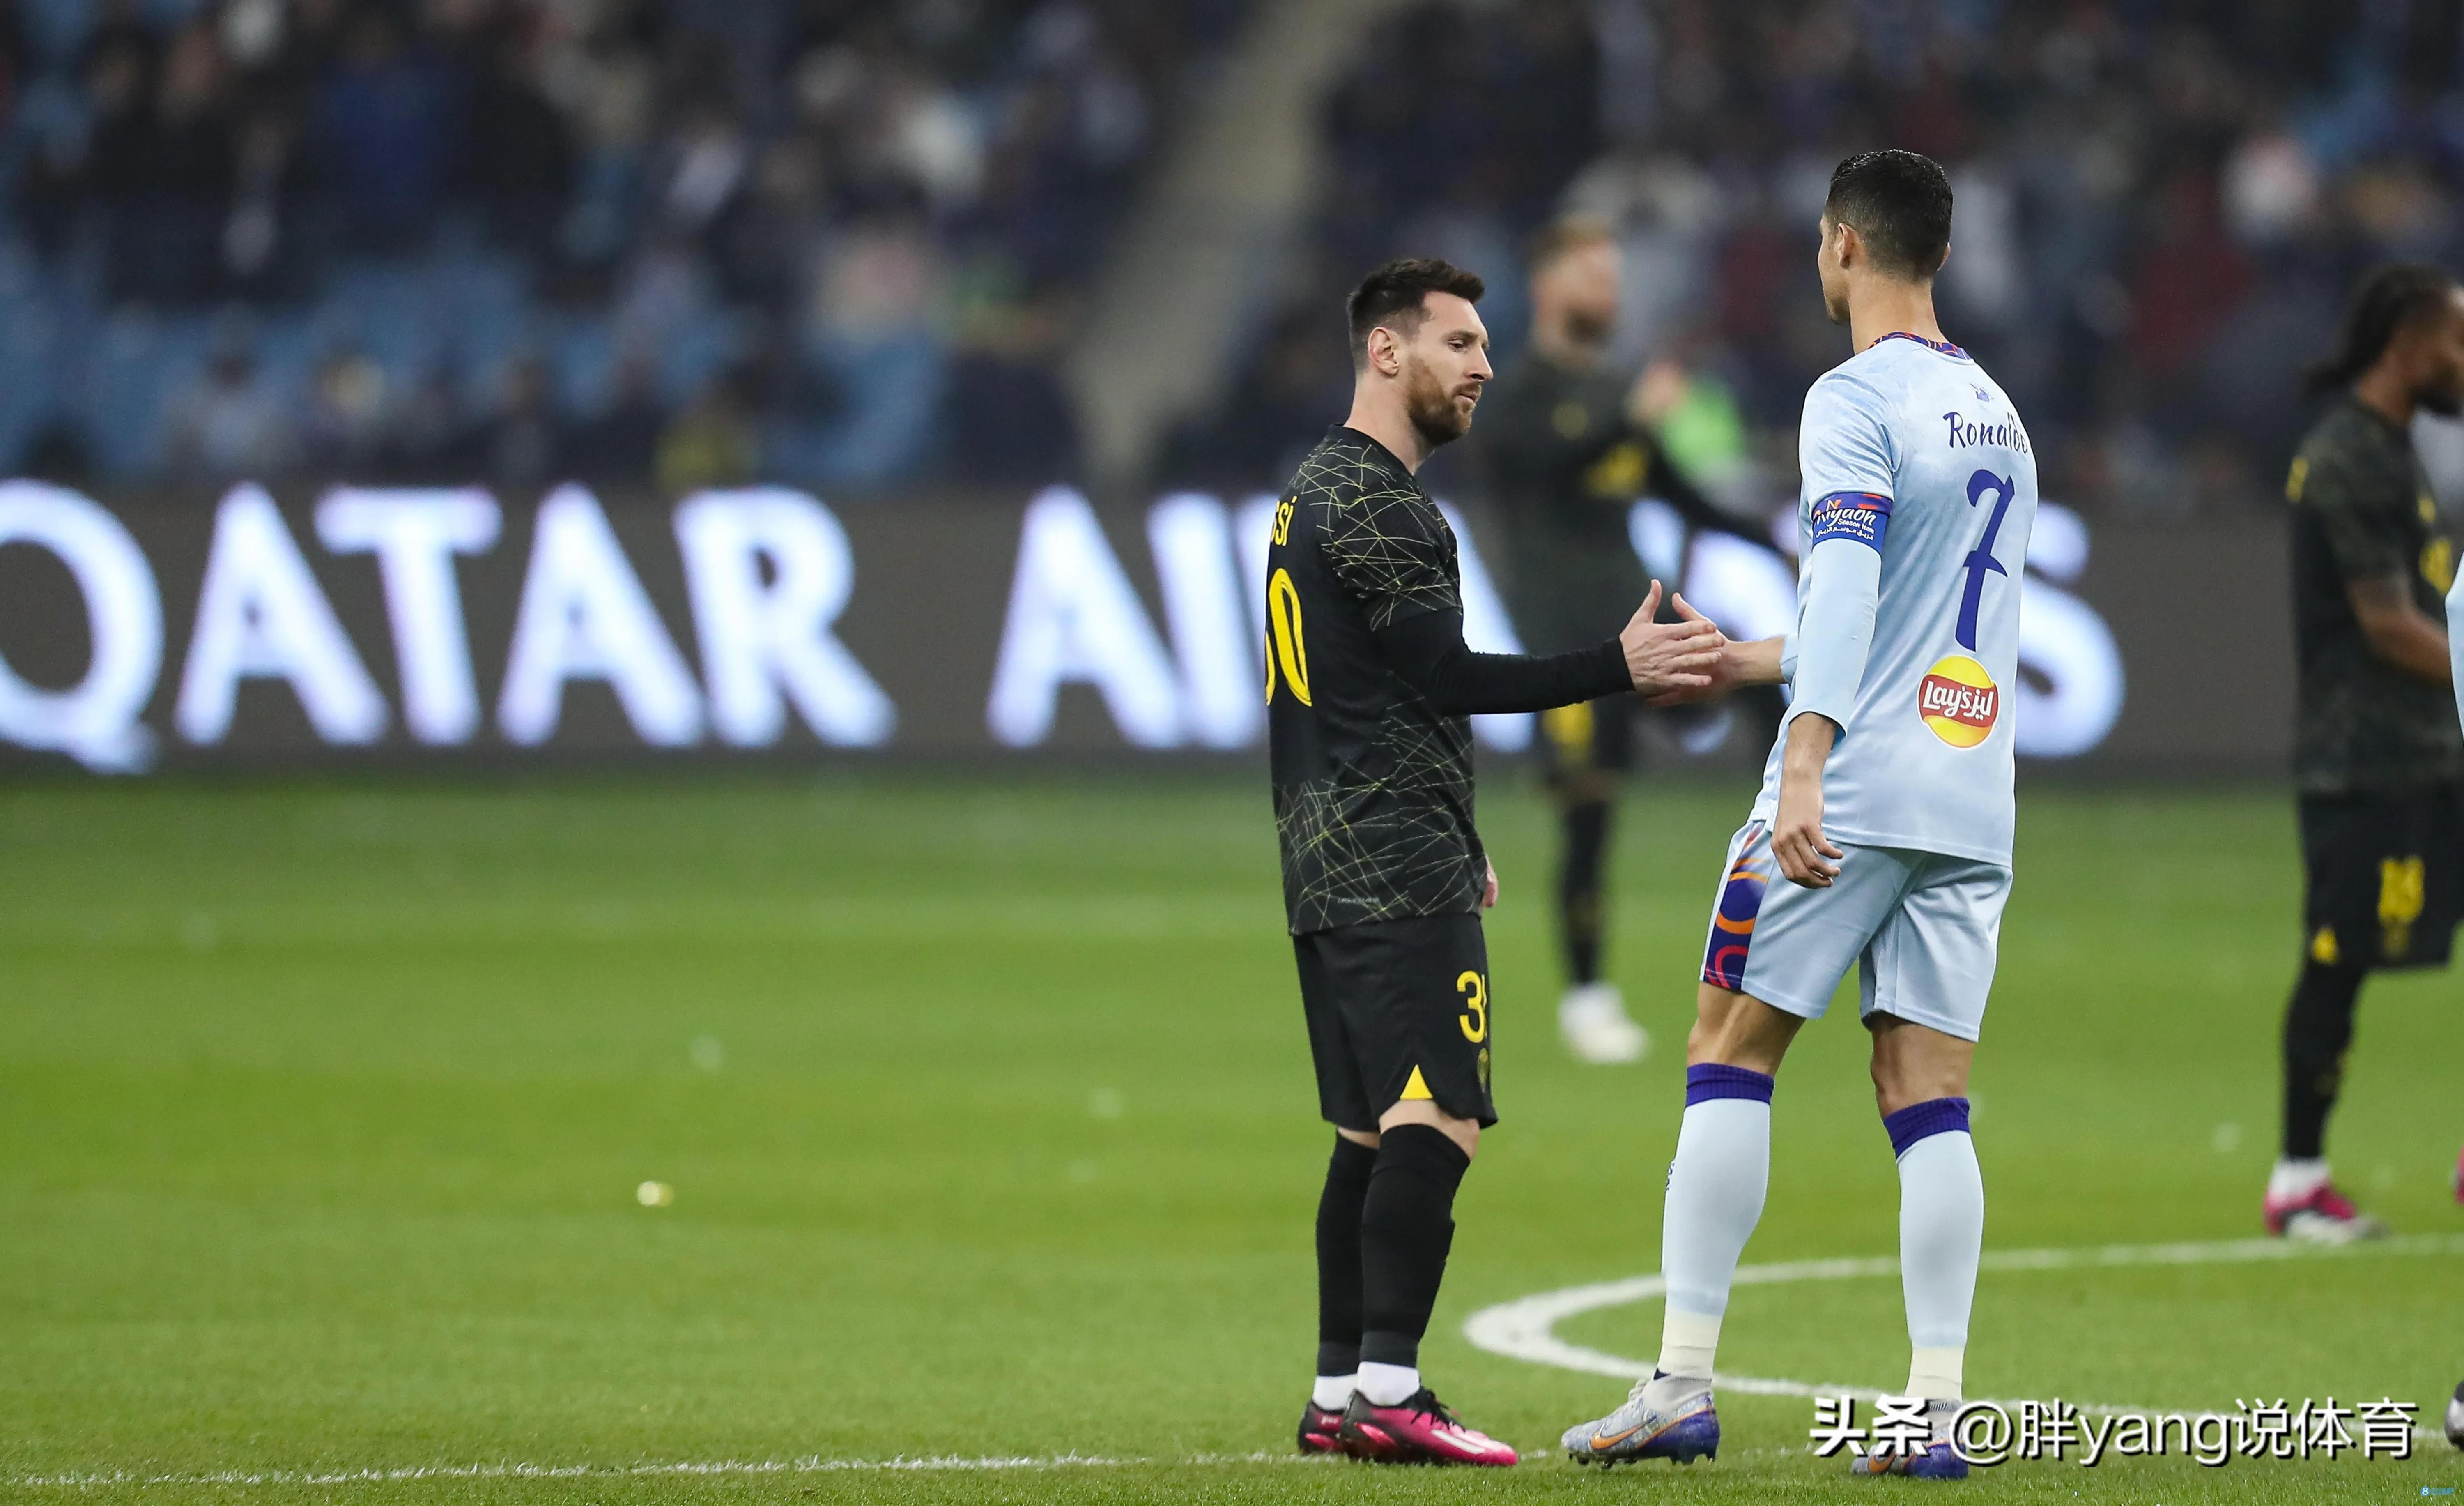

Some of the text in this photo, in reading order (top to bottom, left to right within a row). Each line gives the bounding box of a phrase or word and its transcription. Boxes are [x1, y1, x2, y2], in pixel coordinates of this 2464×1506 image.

[0, 478, 896, 775] QATAR
[1955, 469, 2015, 652] 7
[1266, 568, 1312, 707] 0
[1922, 680, 1973, 718] Lay's
[1457, 970, 1487, 1043] 3
